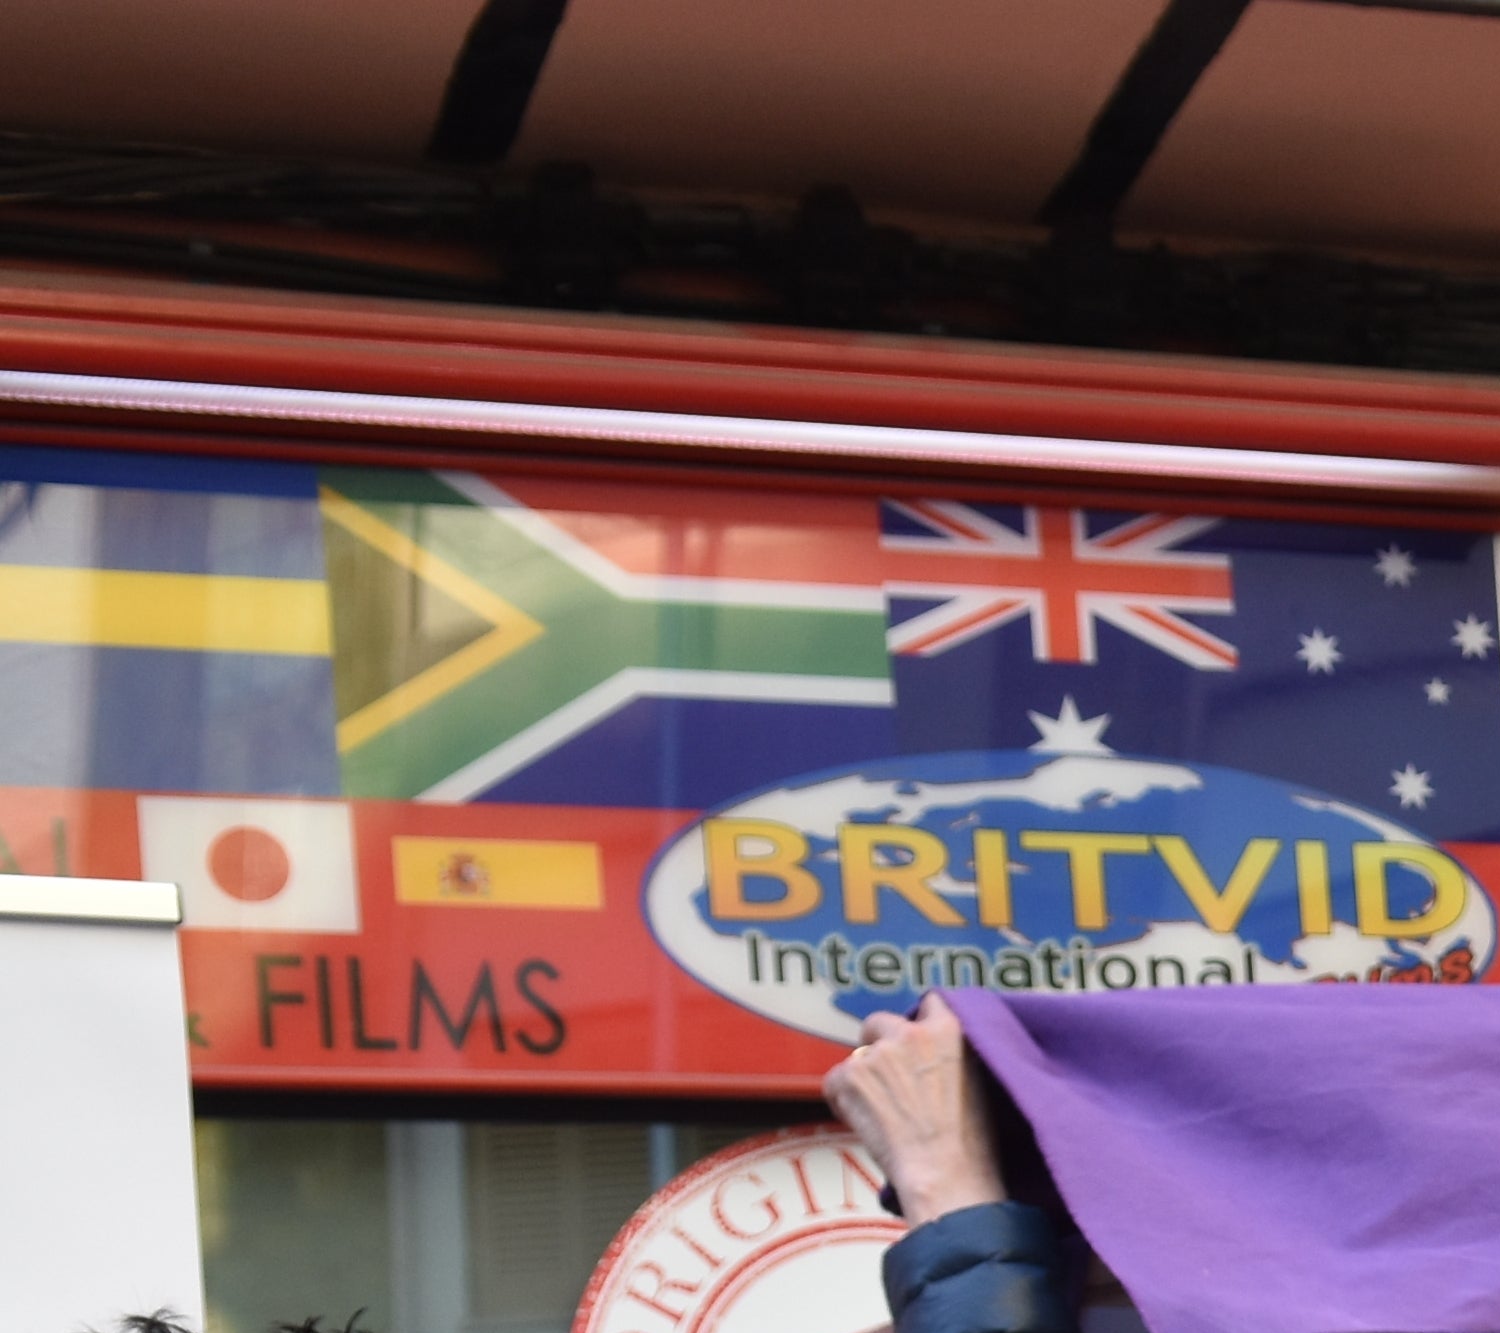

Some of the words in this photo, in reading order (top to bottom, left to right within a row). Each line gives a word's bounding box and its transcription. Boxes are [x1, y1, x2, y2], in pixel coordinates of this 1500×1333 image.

[700, 815, 1470, 942] BRITVID
[253, 952, 568, 1058] FILMS
[744, 930, 1258, 989] International
